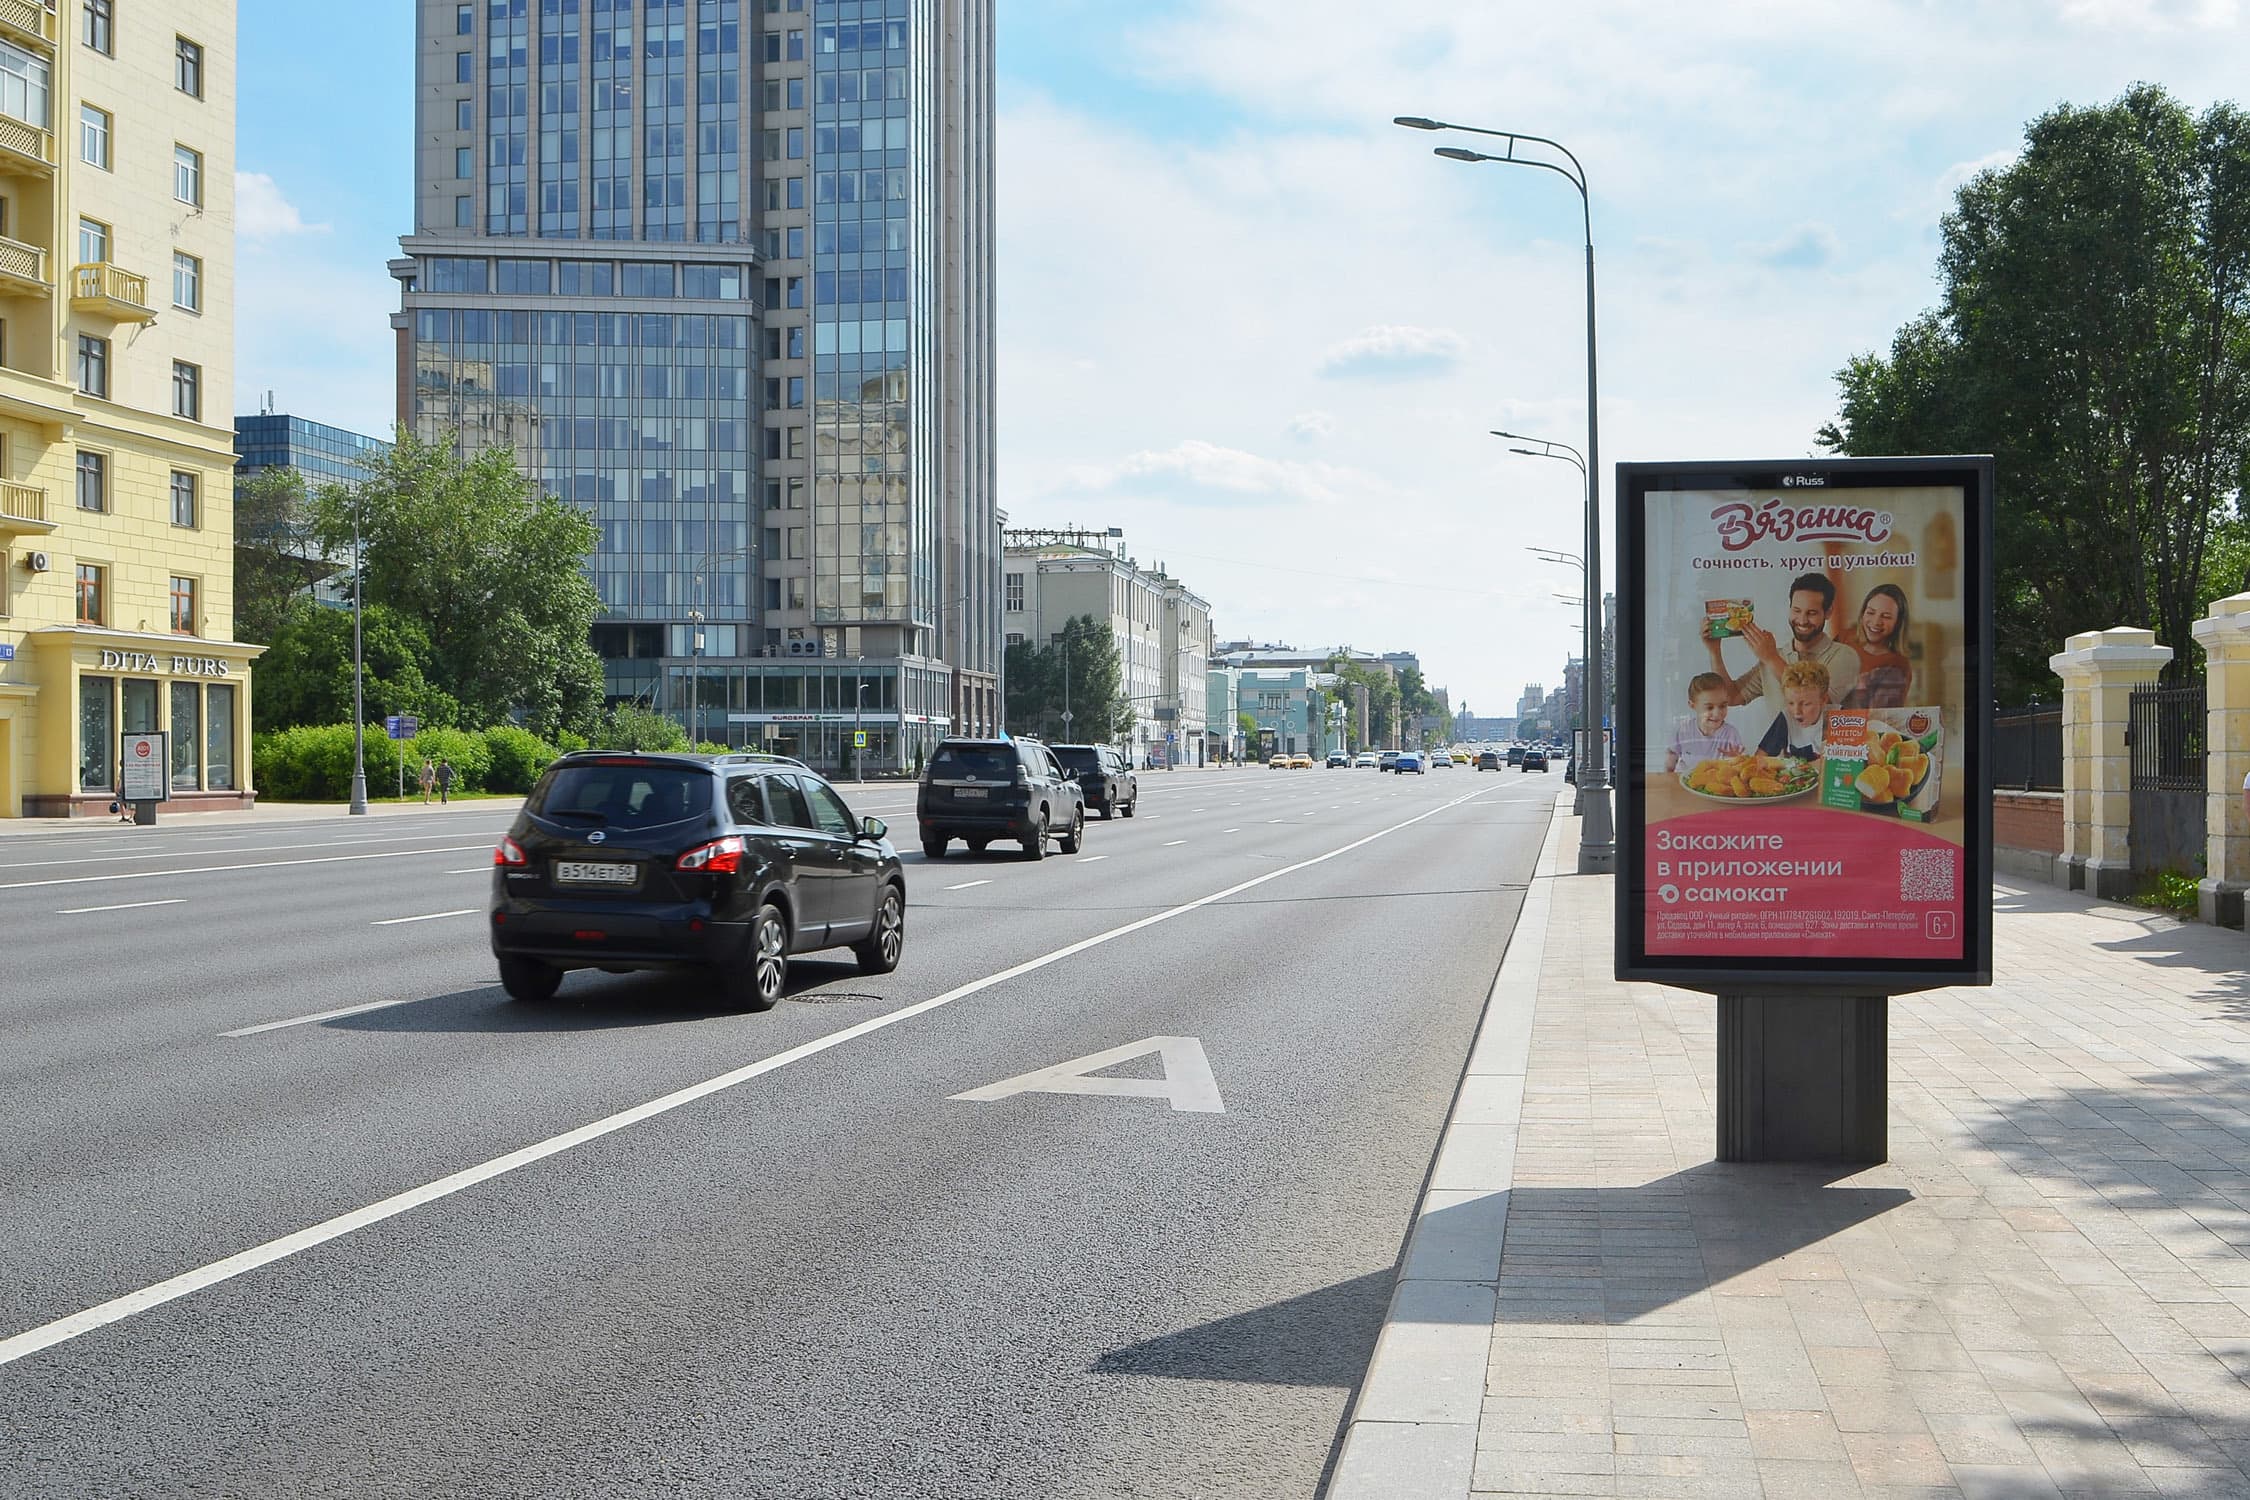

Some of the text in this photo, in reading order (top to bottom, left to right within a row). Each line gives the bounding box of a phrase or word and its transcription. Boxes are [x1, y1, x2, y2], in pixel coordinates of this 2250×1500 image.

[1796, 476, 1825, 486] Russ
[1711, 499, 1889, 551] Вязанка
[1692, 552, 1916, 571] Сочность, хруст и улыбки!
[101, 649, 229, 676] DITA FURS
[1656, 830, 1784, 850] Закажите
[1657, 860, 1843, 881] в приложении
[1684, 885, 1788, 902] самокат
[1933, 916, 1948, 935] 6+
